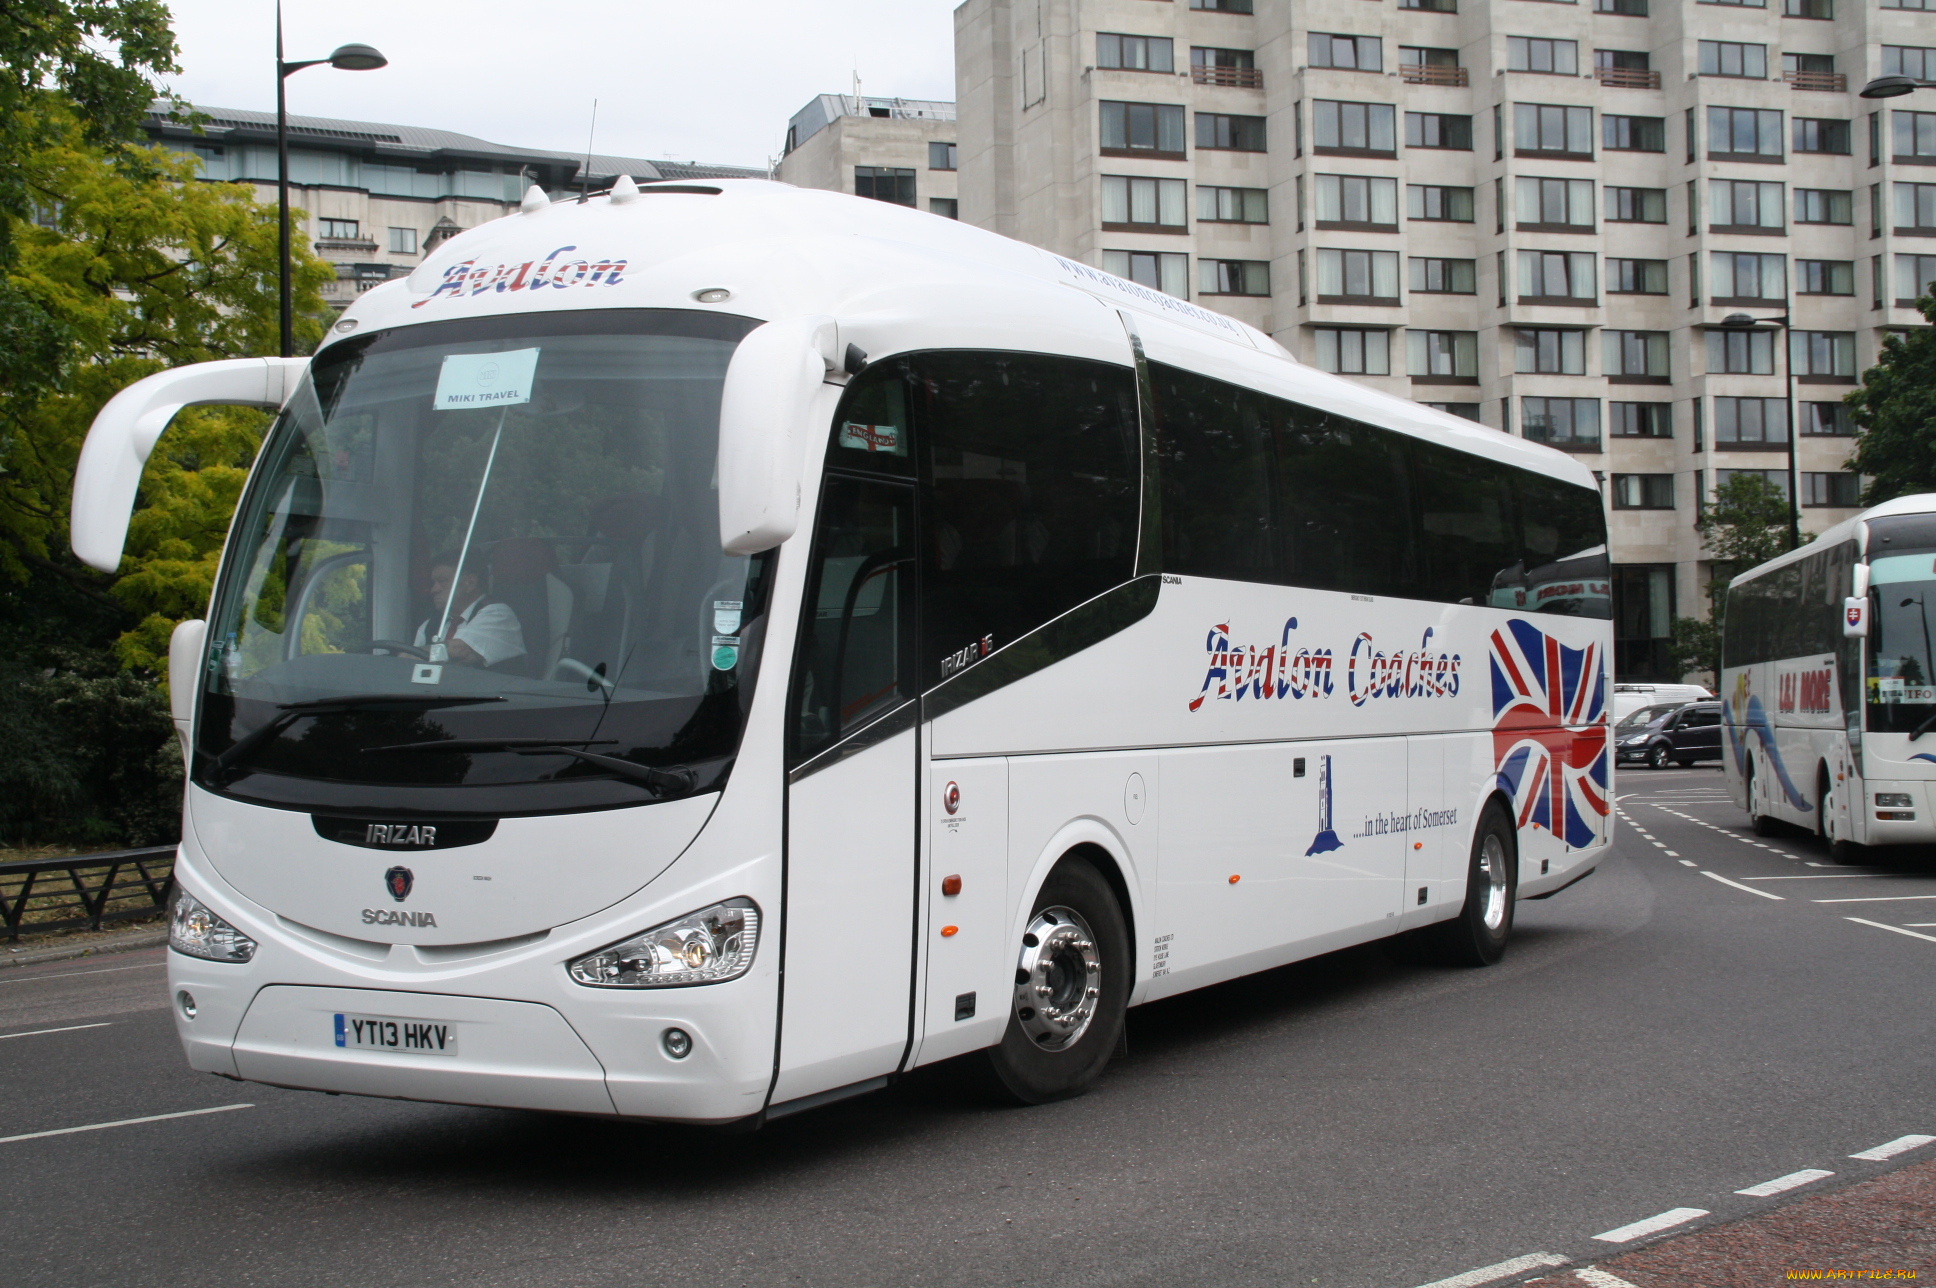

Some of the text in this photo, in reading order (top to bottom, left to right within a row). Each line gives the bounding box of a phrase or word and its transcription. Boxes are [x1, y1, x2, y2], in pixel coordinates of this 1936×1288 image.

[411, 245, 628, 309] Avalon
[1053, 256, 1238, 334] www.avaloncoaches.co.uk
[447, 390, 519, 403] MIKI TRAVEL
[852, 427, 889, 445] ENGLAND
[1162, 575, 1183, 586] SCANIA
[941, 633, 994, 678] IRIZAR i6
[1188, 617, 1461, 713] Avalon Coaches
[365, 824, 437, 846] IRIZAR
[1375, 812, 1389, 835] the
[1390, 811, 1412, 833] heart
[1413, 807, 1422, 830] of
[1423, 807, 1457, 828] Somerset
[361, 908, 438, 928] SCANIA
[352, 1019, 447, 1050] YT13 HKV
